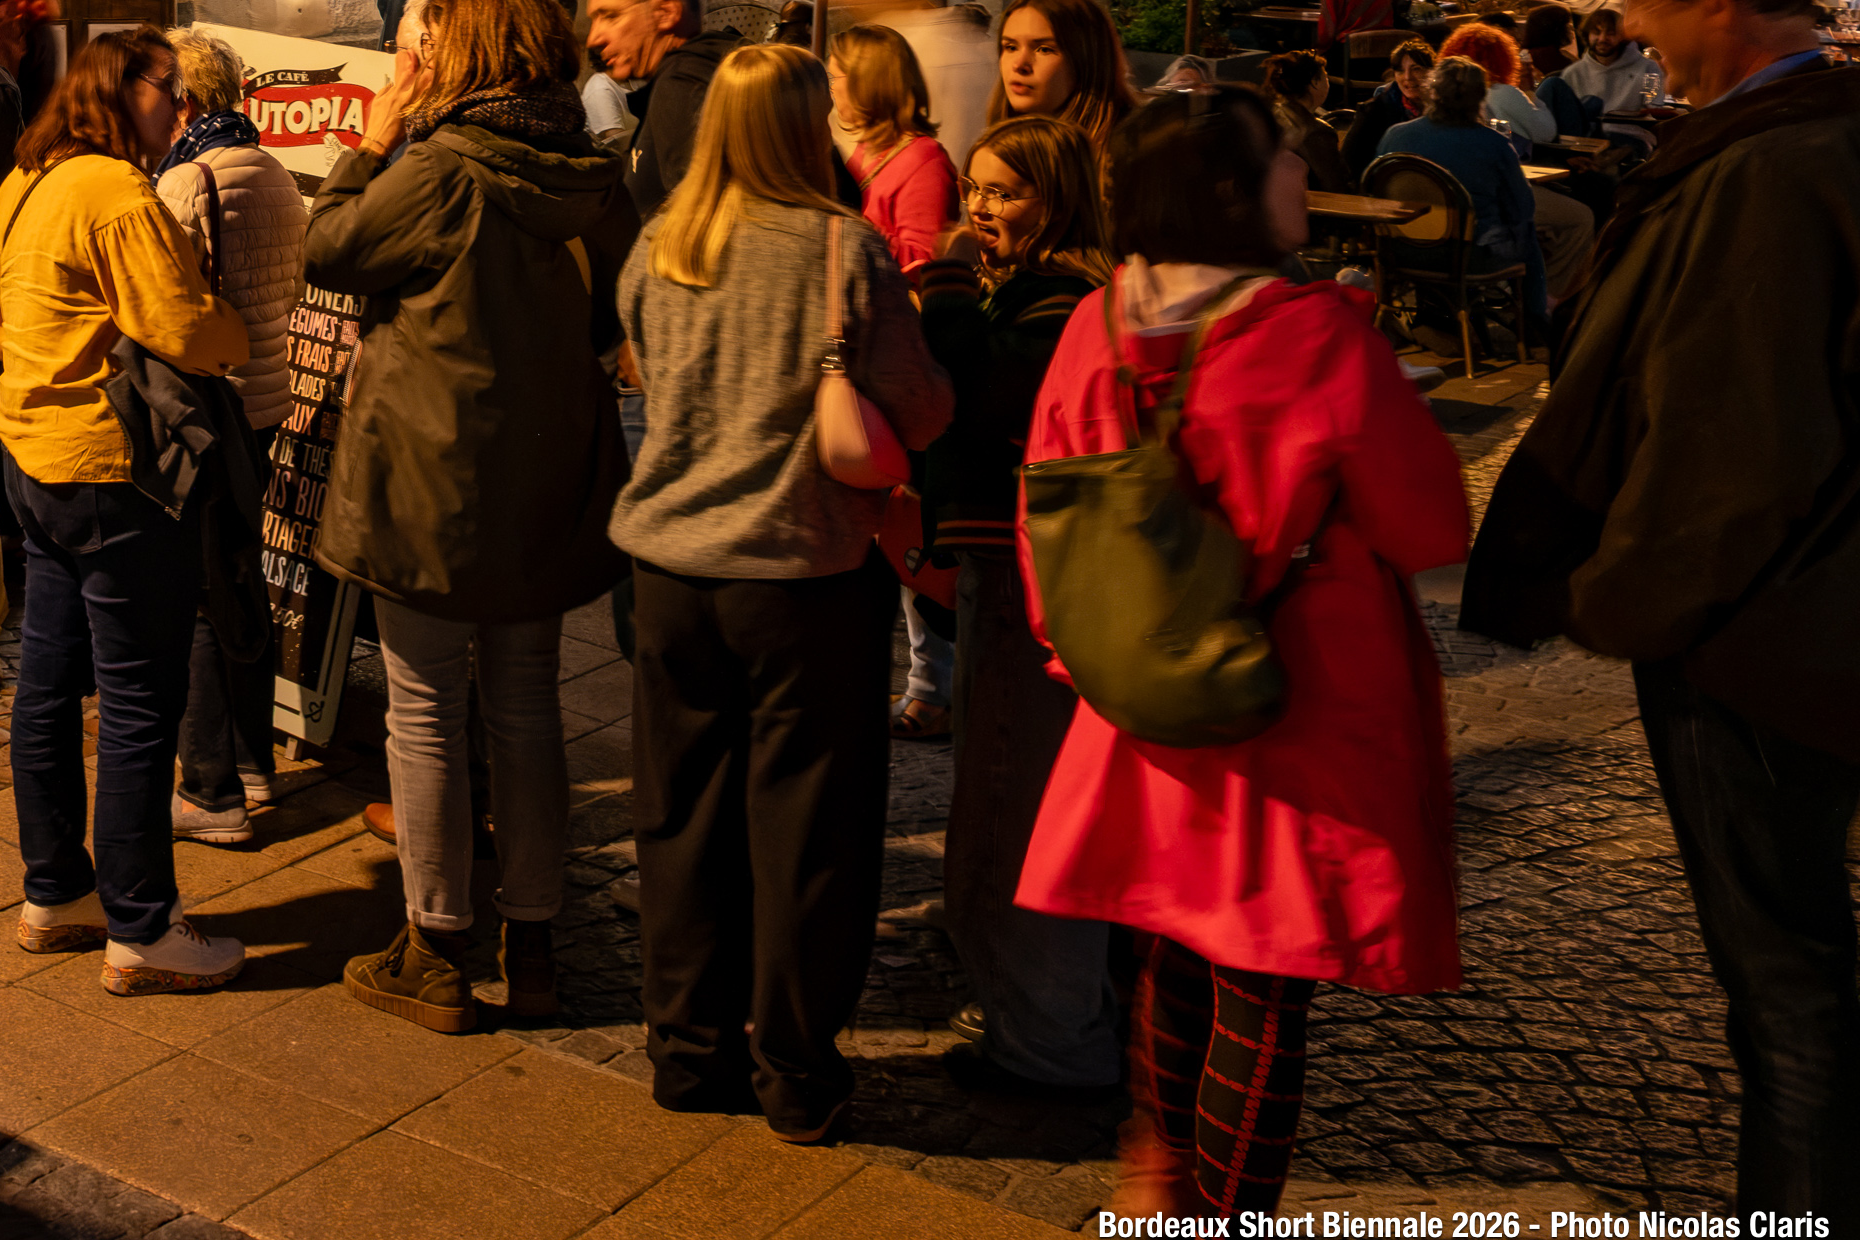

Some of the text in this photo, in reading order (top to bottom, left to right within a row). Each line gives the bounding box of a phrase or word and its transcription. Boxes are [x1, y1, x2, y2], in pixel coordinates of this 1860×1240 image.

[256, 71, 310, 88] LE CAFÉ
[249, 96, 364, 135] UTOPIA
[295, 338, 332, 373] FRAIS
[279, 435, 300, 468] DE
